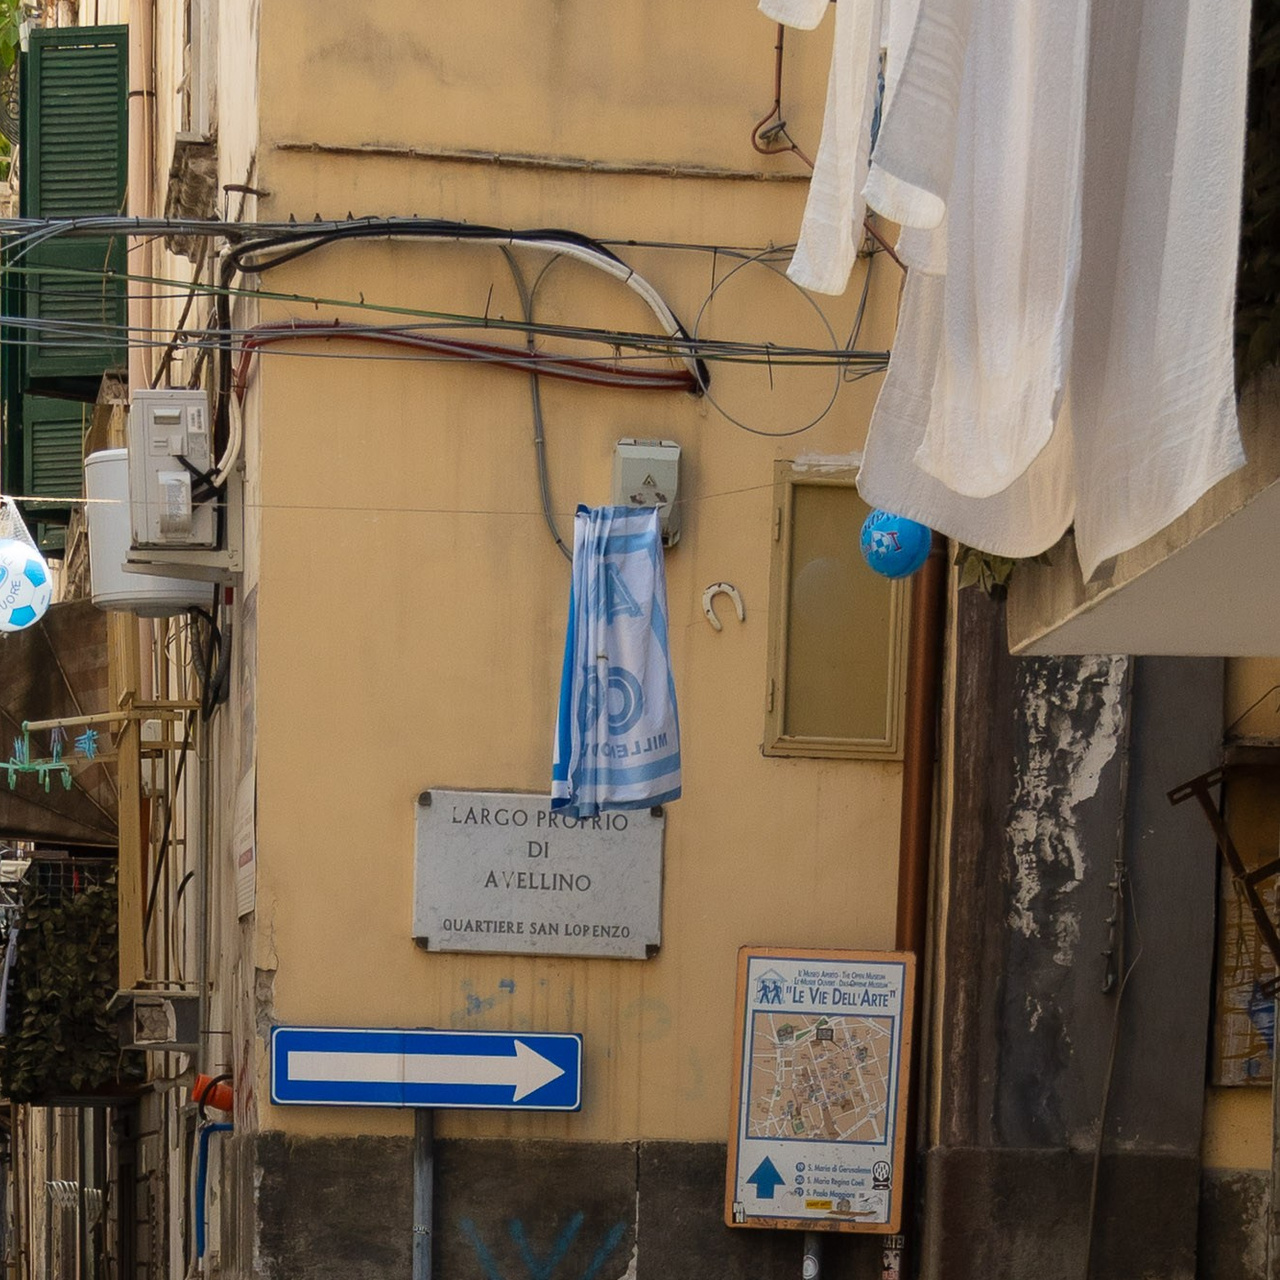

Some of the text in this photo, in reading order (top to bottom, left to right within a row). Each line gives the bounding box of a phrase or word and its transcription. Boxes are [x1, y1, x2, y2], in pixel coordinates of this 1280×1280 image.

[452, 806, 528, 827] LARGO
[527, 840, 549, 859] DI
[484, 870, 591, 892] AVELLINO
[442, 918, 524, 934] QUARTIERE
[529, 922, 559, 936] SAN
[814, 1164, 831, 1172] Maria
[813, 1177, 830, 1185] Maria
[831, 1178, 850, 1187] Regina
[813, 1189, 828, 1198] Paolo
[829, 1190, 856, 1200] Maggiore
